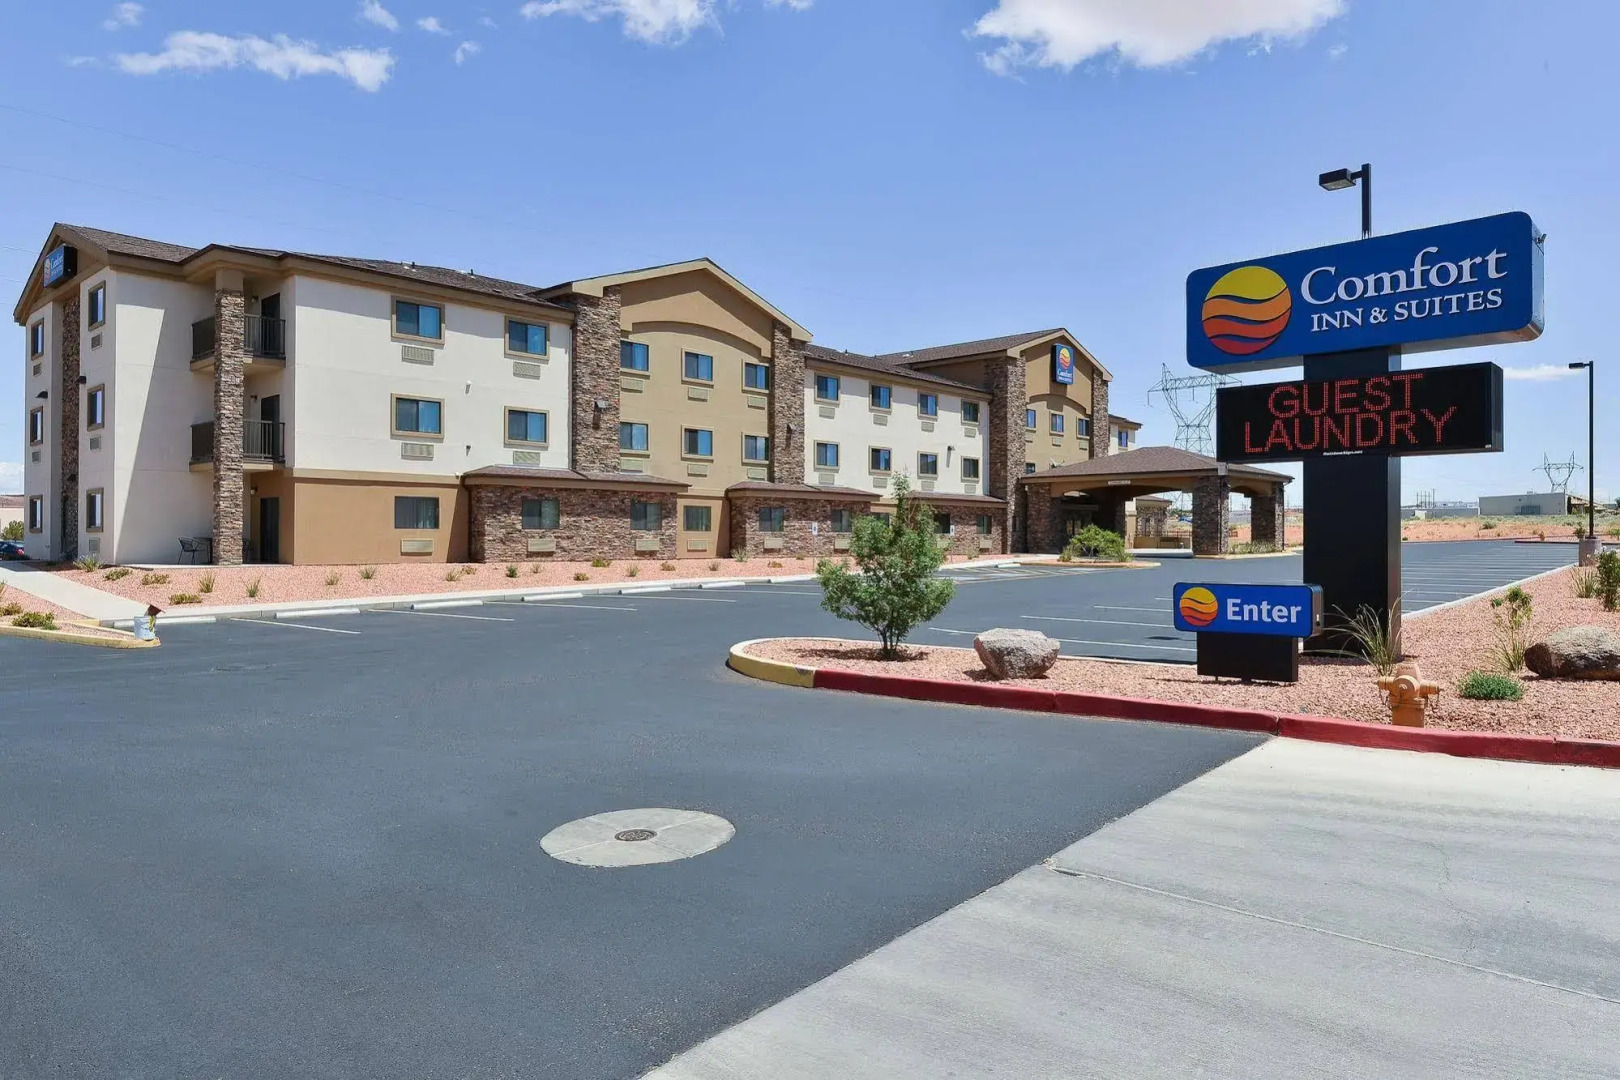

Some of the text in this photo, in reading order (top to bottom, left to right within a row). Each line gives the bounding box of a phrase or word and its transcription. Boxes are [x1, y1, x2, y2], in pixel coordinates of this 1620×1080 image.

[1301, 246, 1508, 305] Comfort
[1310, 288, 1502, 332] INN & SUITES
[1268, 373, 1423, 418] GUEST
[1245, 406, 1457, 453] LAUNDRY
[1227, 598, 1302, 623] Enter
